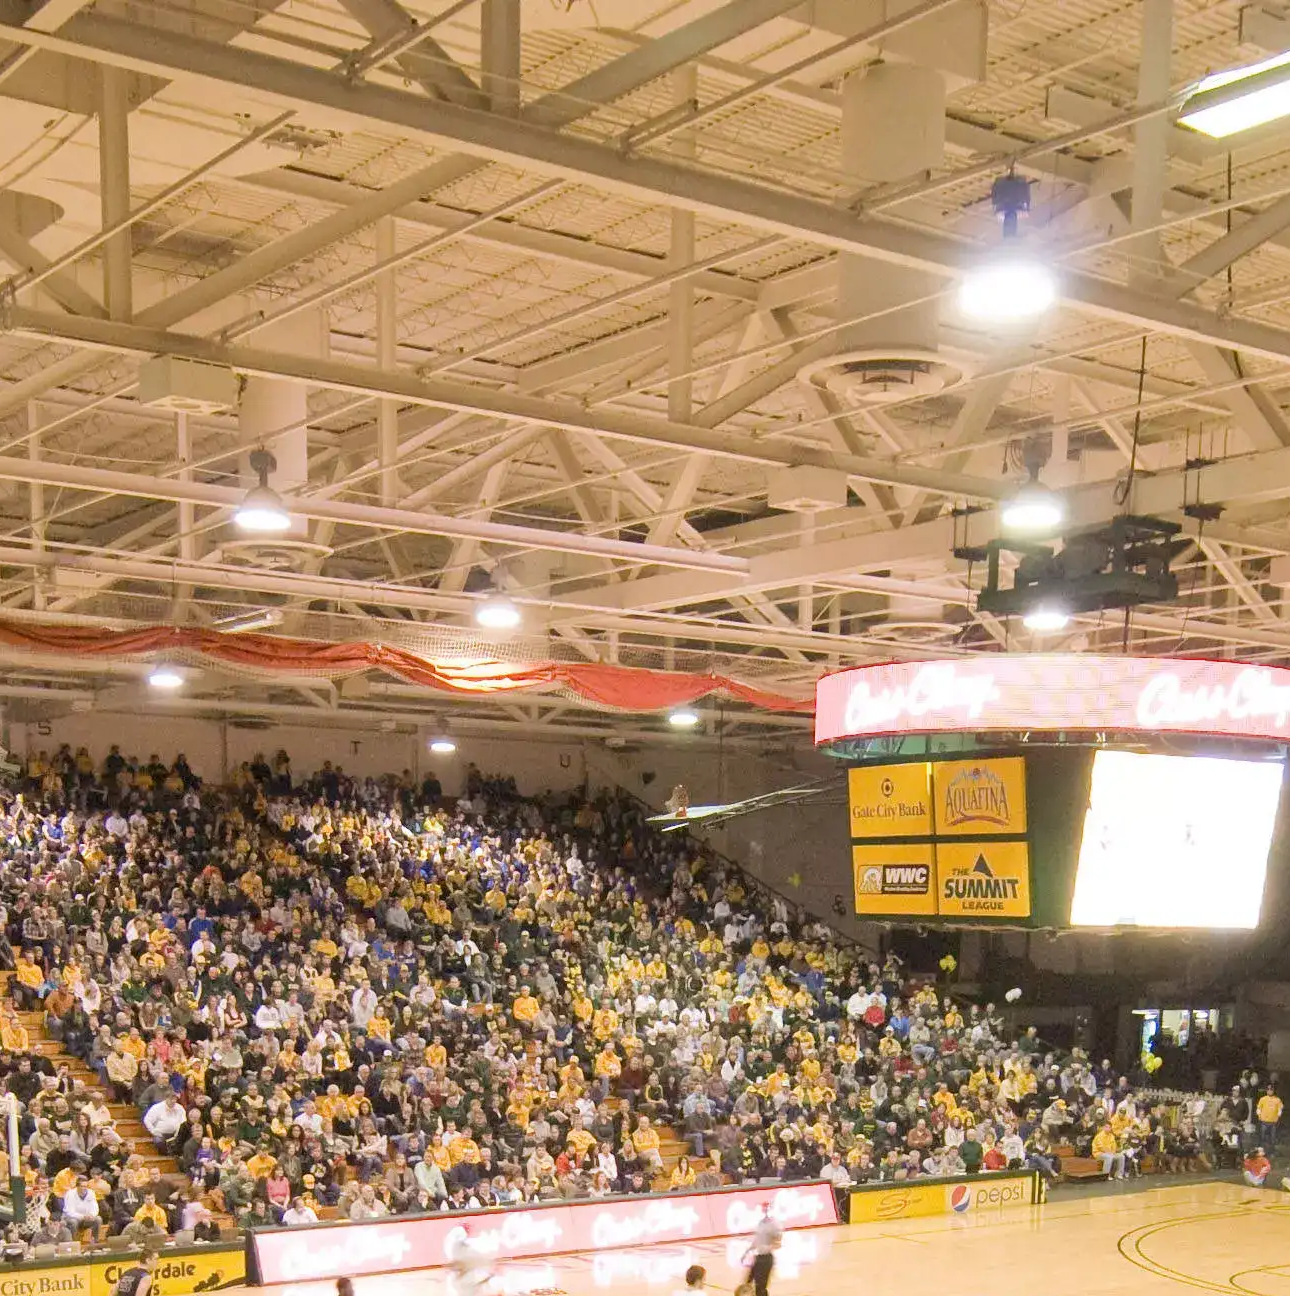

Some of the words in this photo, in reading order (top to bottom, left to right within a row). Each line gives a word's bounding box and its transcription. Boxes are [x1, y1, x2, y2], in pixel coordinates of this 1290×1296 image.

[853, 803, 876, 819] Gate
[877, 802, 897, 822] City
[899, 801, 926, 817] Bank
[945, 783, 1010, 822] AQUAFINA
[885, 867, 927, 884] WWC
[952, 867, 970, 876] THE
[944, 878, 1019, 899] SUMMIT
[962, 901, 1004, 911] LEAGUE
[975, 1181, 1025, 1209] pepsi
[104, 1261, 196, 1284] Clrdale
[38, 1273, 85, 1294] Bank
